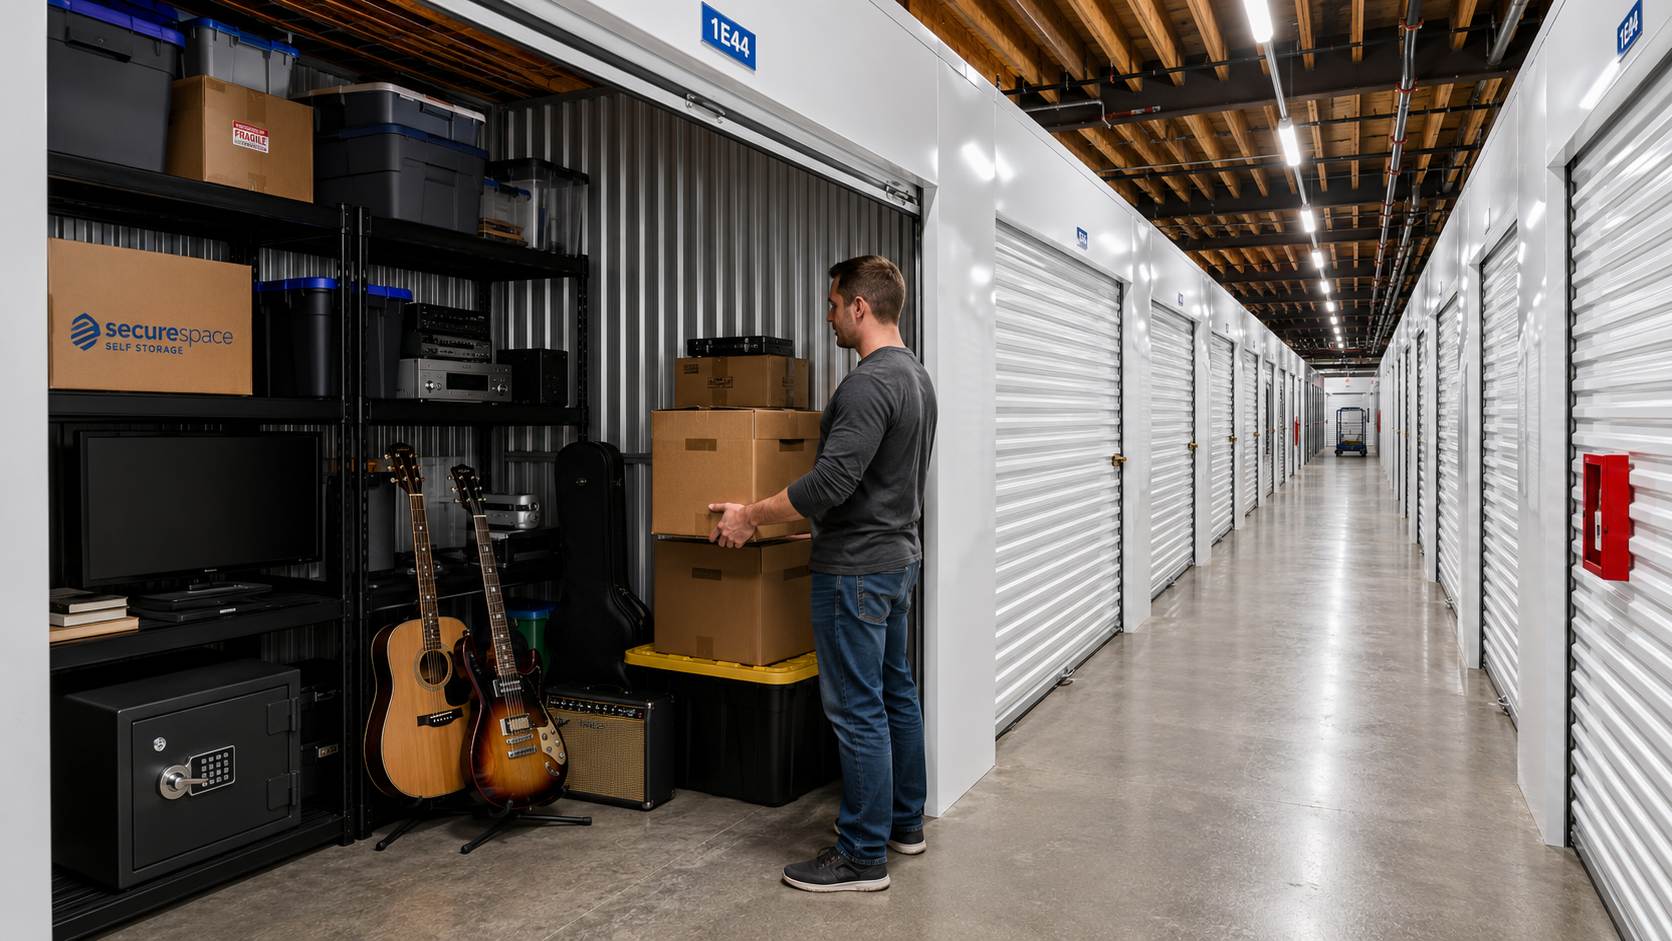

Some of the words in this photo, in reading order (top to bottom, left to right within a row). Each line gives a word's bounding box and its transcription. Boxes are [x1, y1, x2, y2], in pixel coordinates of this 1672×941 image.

[711, 17, 750, 58] 1E44
[234, 129, 267, 146] FRAGILE
[105, 321, 234, 348] securespace
[105, 342, 132, 352] SELF
[135, 343, 184, 355] STORAGE
